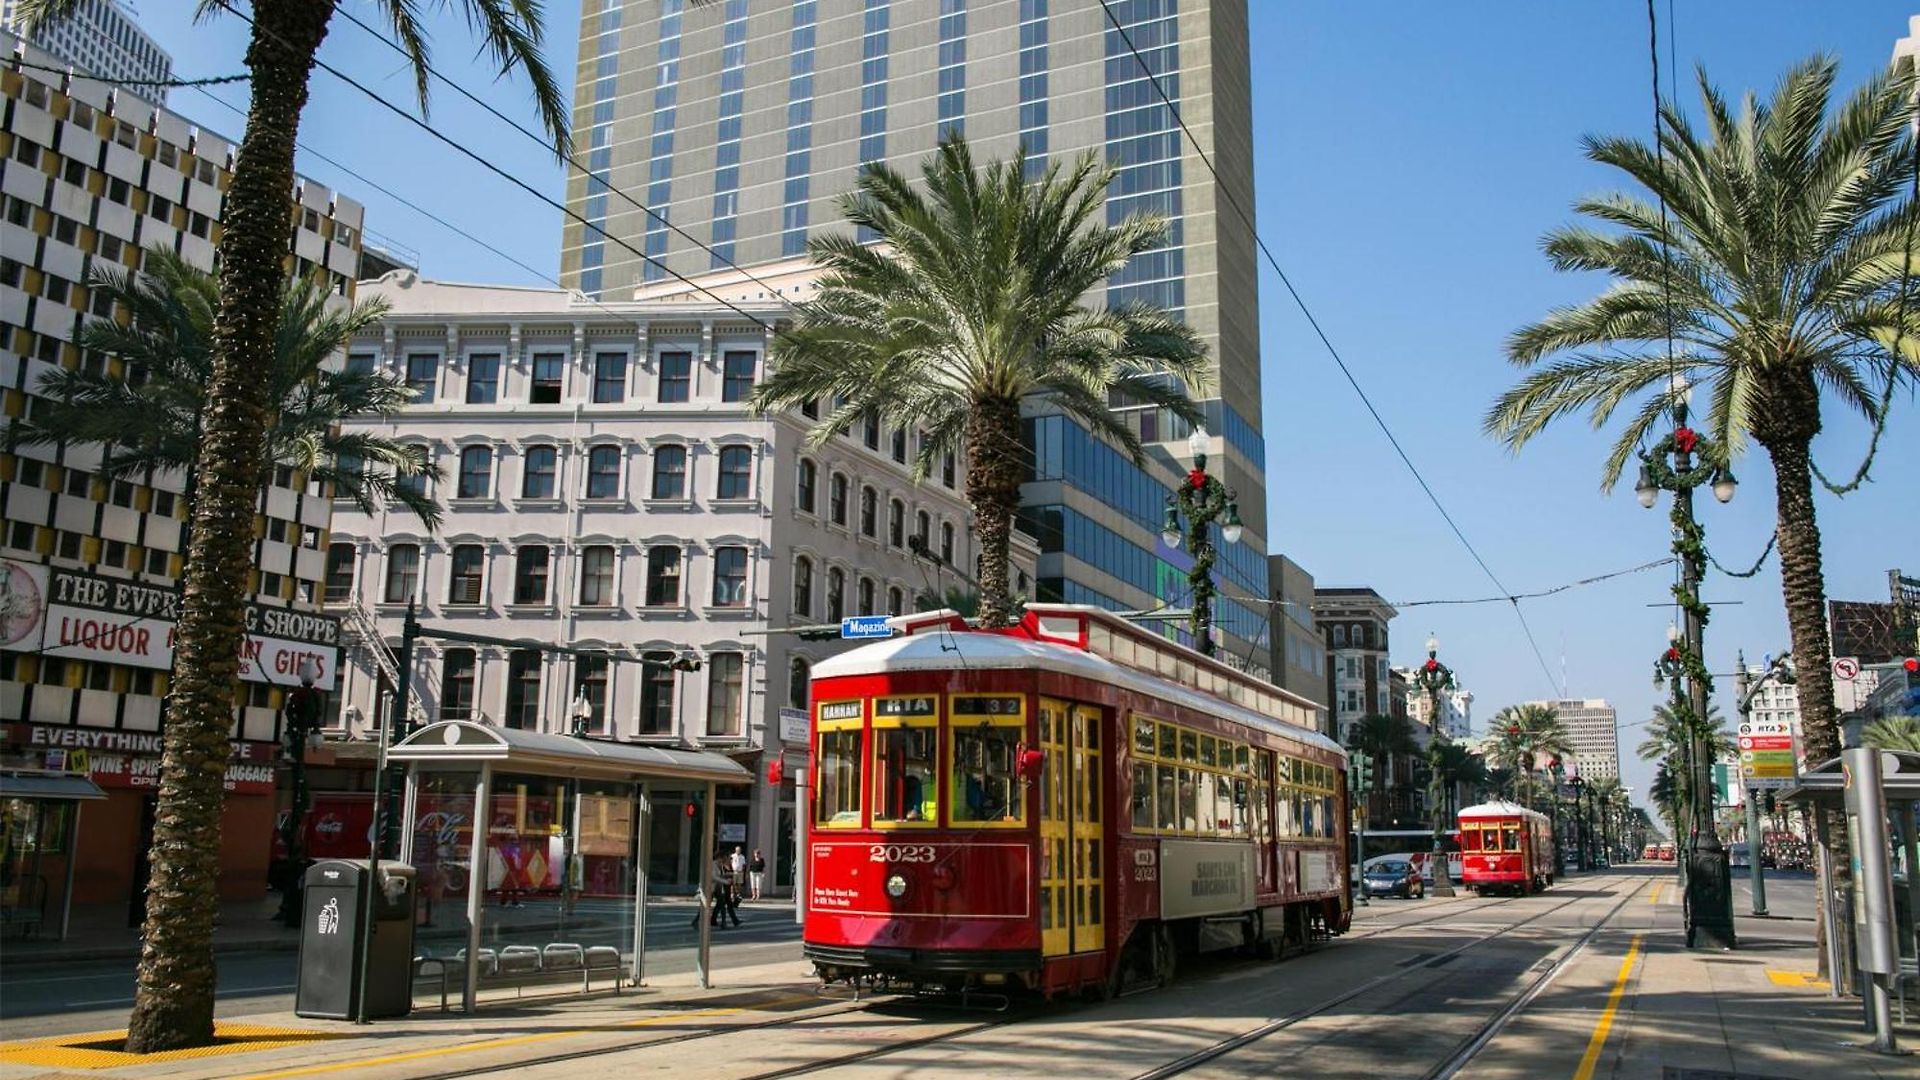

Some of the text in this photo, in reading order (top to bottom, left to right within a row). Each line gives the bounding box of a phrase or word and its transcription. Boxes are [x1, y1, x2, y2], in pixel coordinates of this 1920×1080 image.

[56, 573, 179, 618] THE EVER
[60, 616, 150, 656] LIQUOR
[263, 610, 337, 643] SHOPPE
[89, 756, 158, 776] WINE SPIR
[869, 845, 936, 863] 2023
